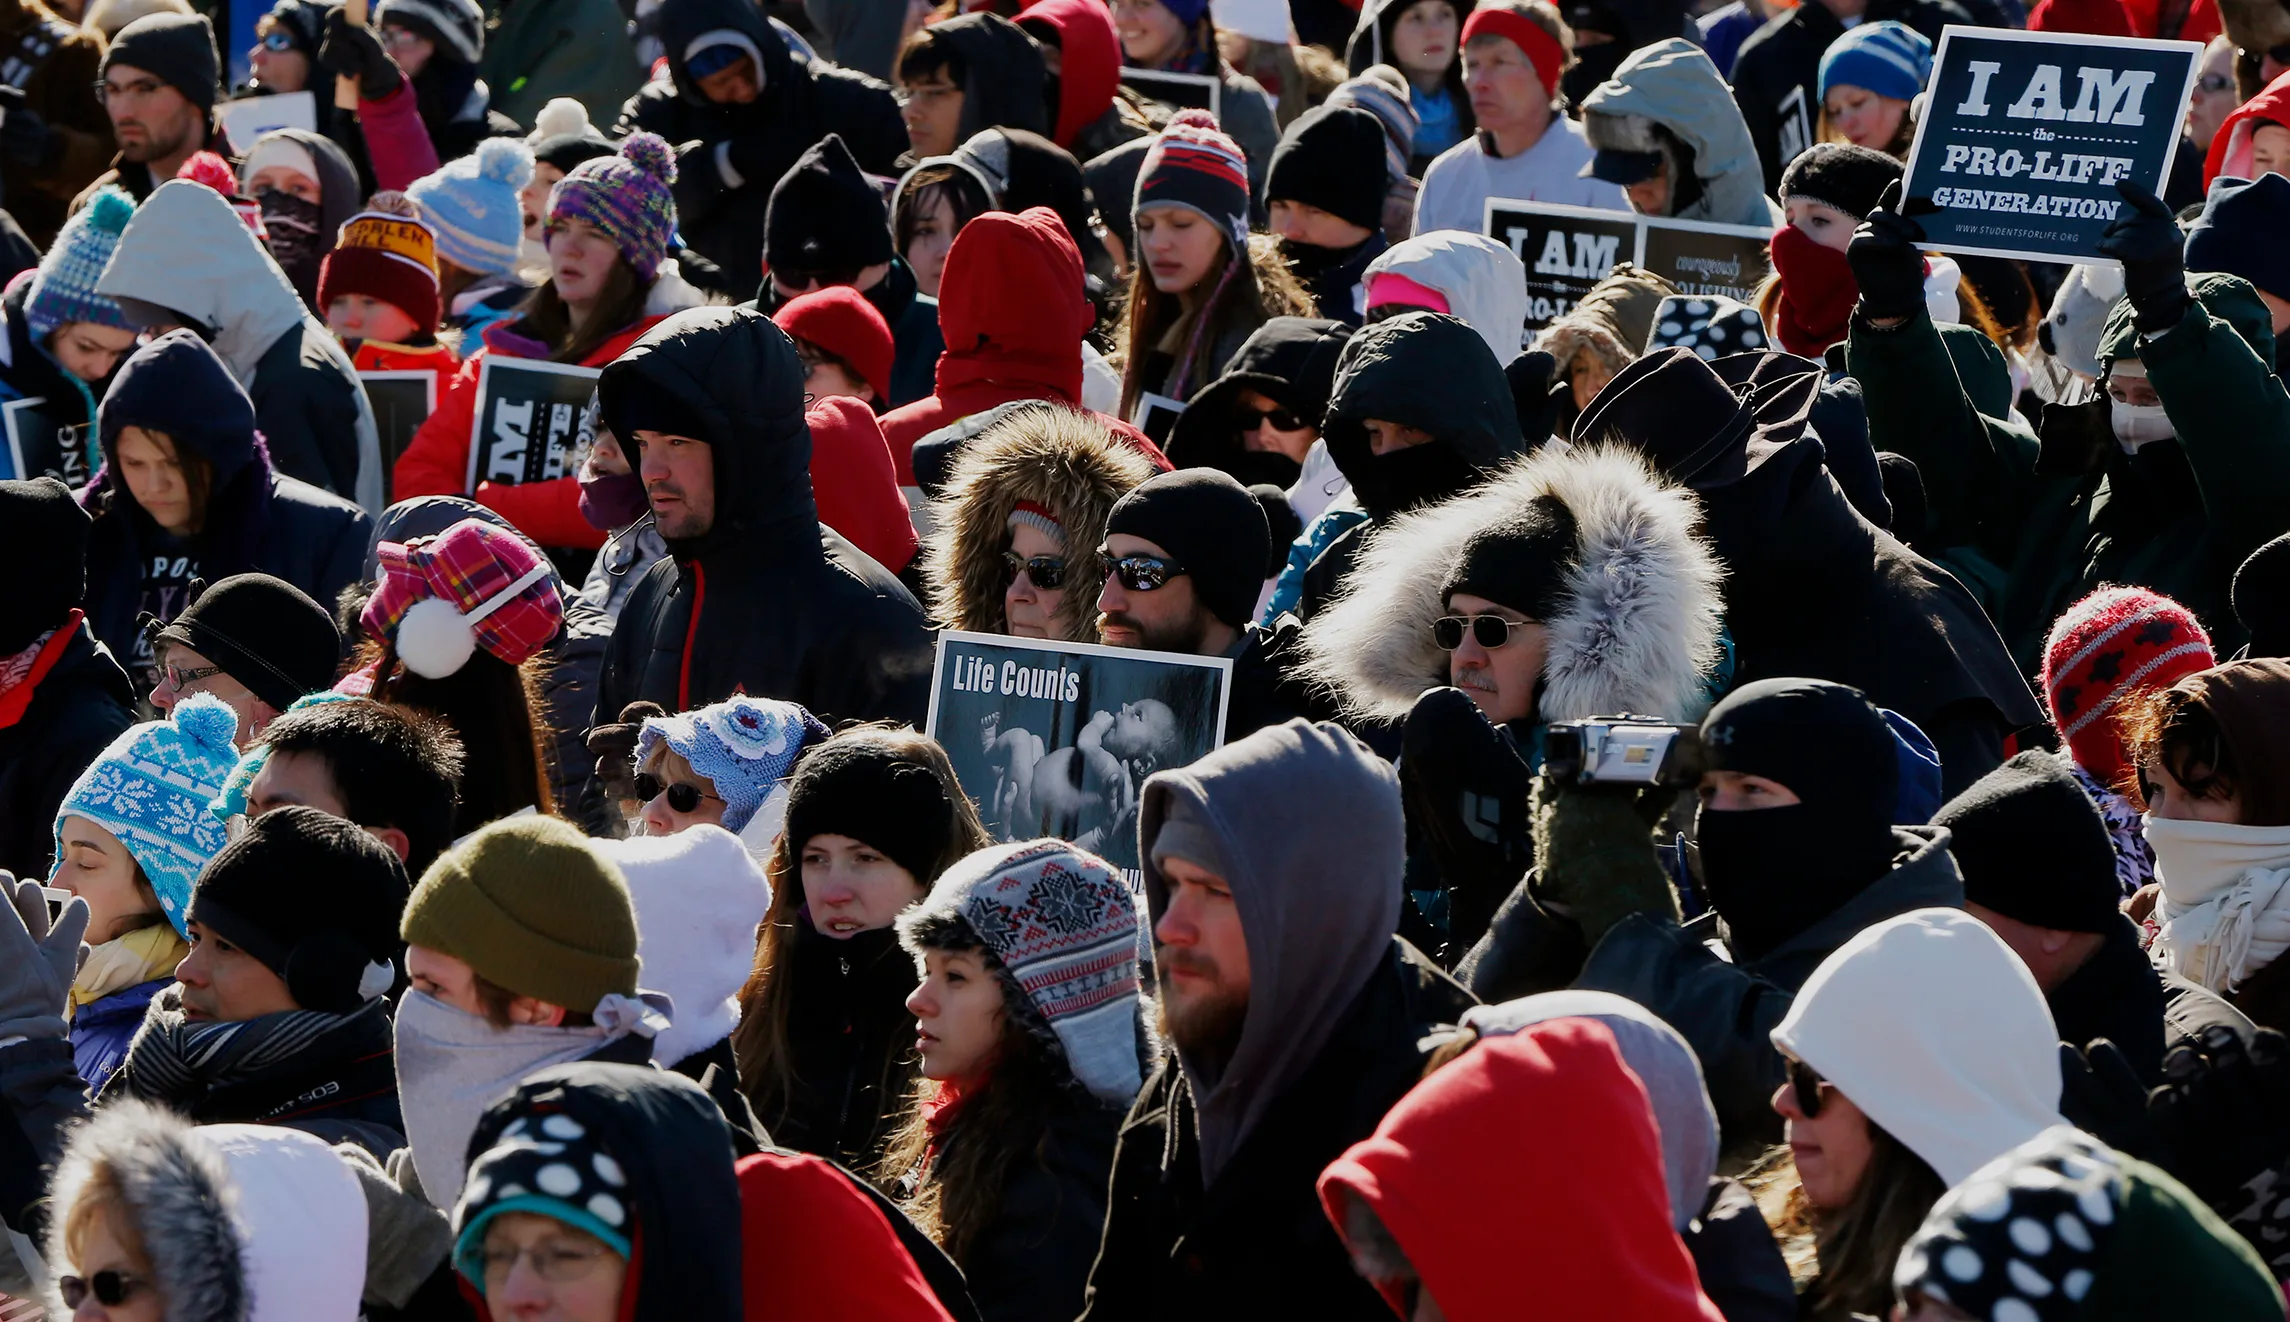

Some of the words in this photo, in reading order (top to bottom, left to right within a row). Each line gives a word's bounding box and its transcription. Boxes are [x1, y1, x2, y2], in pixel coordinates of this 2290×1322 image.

[1956, 60, 2001, 117] I
[2006, 63, 2157, 127] AM
[2032, 127, 2056, 142] the
[1940, 144, 2134, 187] PRO-LIFE
[1931, 186, 2122, 221] GENERATION
[1534, 230, 1620, 279] AM
[1955, 223, 2080, 243] WWW.STUDENTSFORLIFE.ORG
[57, 424, 86, 486] ING
[953, 655, 995, 694] Life
[1000, 660, 1080, 703] Counts
